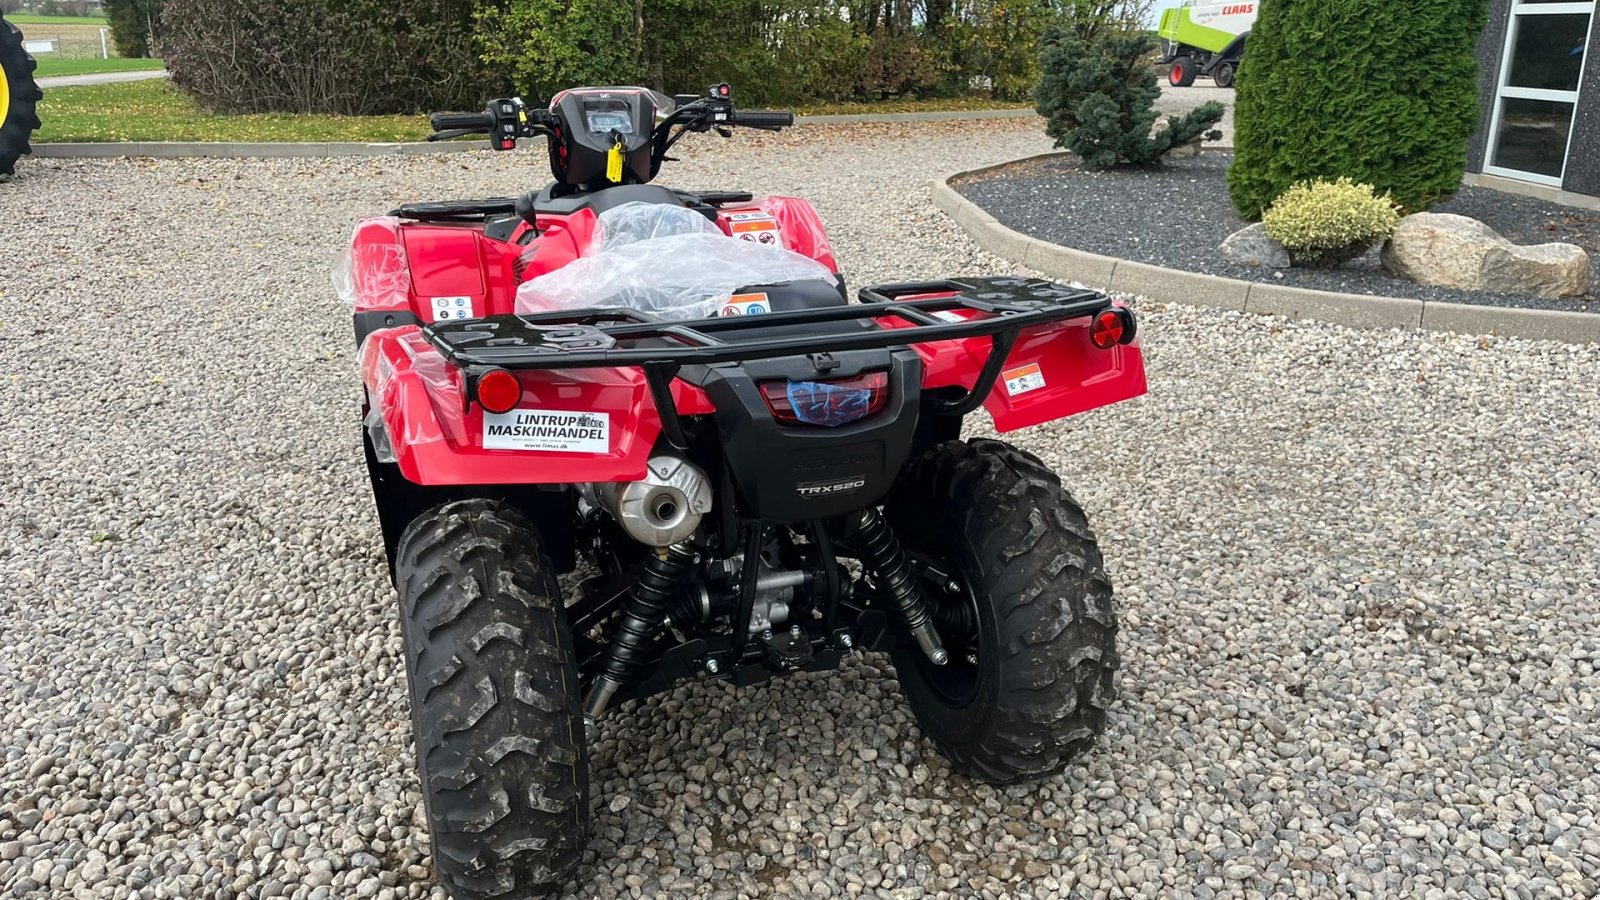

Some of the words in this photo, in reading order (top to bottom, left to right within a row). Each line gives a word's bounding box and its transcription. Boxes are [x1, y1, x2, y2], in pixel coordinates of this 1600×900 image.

[1222, 4, 1254, 15] CLAAS
[516, 414, 577, 426] LINTRUP
[487, 425, 605, 440] MASKINHANDEL
[797, 480, 865, 495] TRX520
